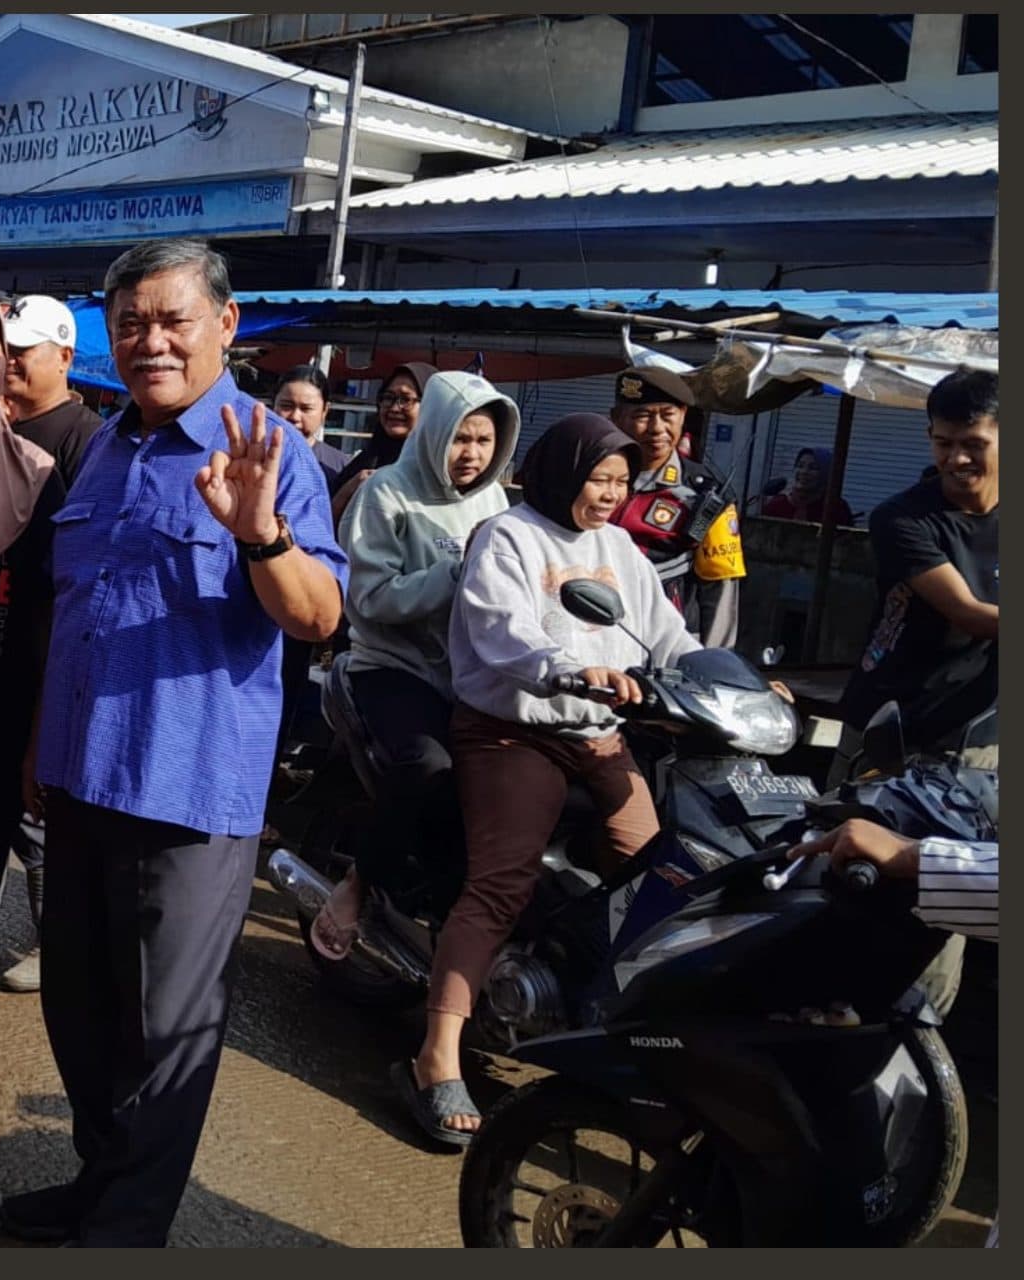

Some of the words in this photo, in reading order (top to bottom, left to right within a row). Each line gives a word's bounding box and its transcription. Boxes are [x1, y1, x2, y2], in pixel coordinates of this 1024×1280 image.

[56, 79, 188, 130] RAKYAT
[67, 124, 157, 158] MORAWA
[42, 200, 118, 225] TANJUNG
[123, 194, 205, 220] MORAWA
[629, 1035, 685, 1049] HONDA
